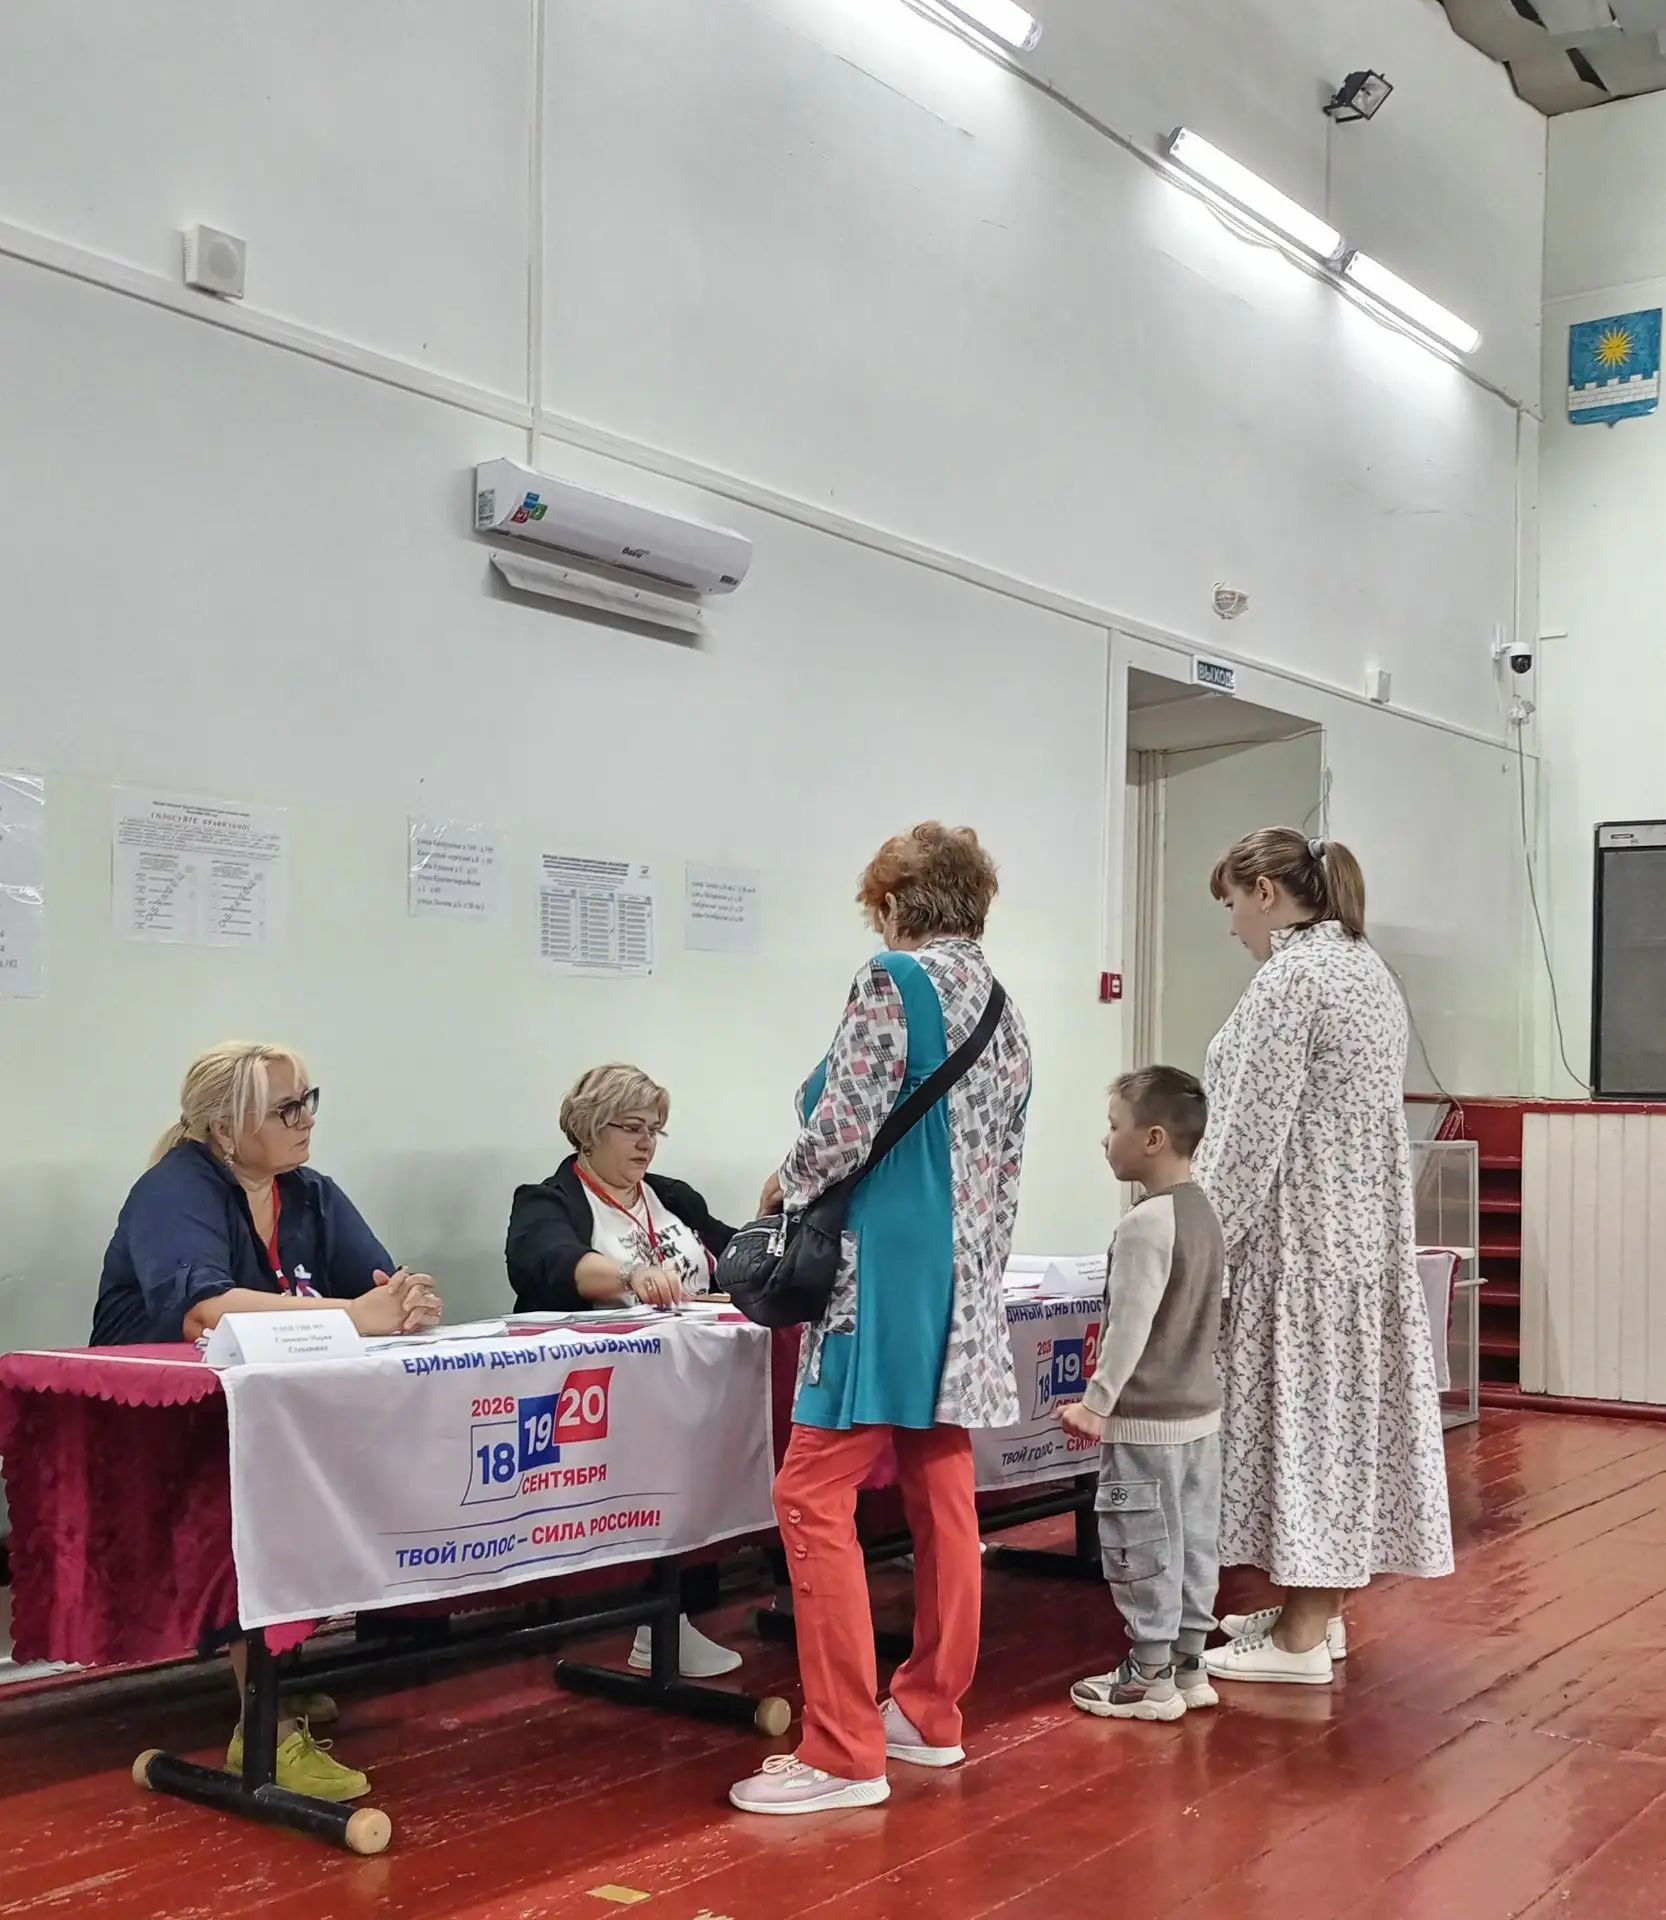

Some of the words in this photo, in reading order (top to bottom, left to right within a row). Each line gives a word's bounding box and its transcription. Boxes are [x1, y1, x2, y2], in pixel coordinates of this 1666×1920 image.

[1006, 1305, 1044, 1324] ДИНЫЙ
[402, 1350, 486, 1375] ЕДИНЫЙ
[490, 1347, 538, 1370] ДЕНЬ
[538, 1337, 661, 1362] ГОЛОСОВАНИЯ
[1085, 1335, 1097, 1366] 2
[1056, 1352, 1081, 1383] 19
[1039, 1372, 1050, 1406] 18
[471, 1396, 515, 1417] 2026
[558, 1385, 606, 1428] 20
[524, 1412, 552, 1456] 19
[476, 1442, 516, 1486] 18
[1001, 1446, 1028, 1467] ТВОЙ
[522, 1464, 607, 1495] СЕНТЯБРЯ
[395, 1541, 457, 1569] ТВОЙ
[461, 1534, 516, 1562] ГОЛОС
[531, 1520, 587, 1546] СИЛА
[590, 1510, 661, 1537] РОССИИ!
